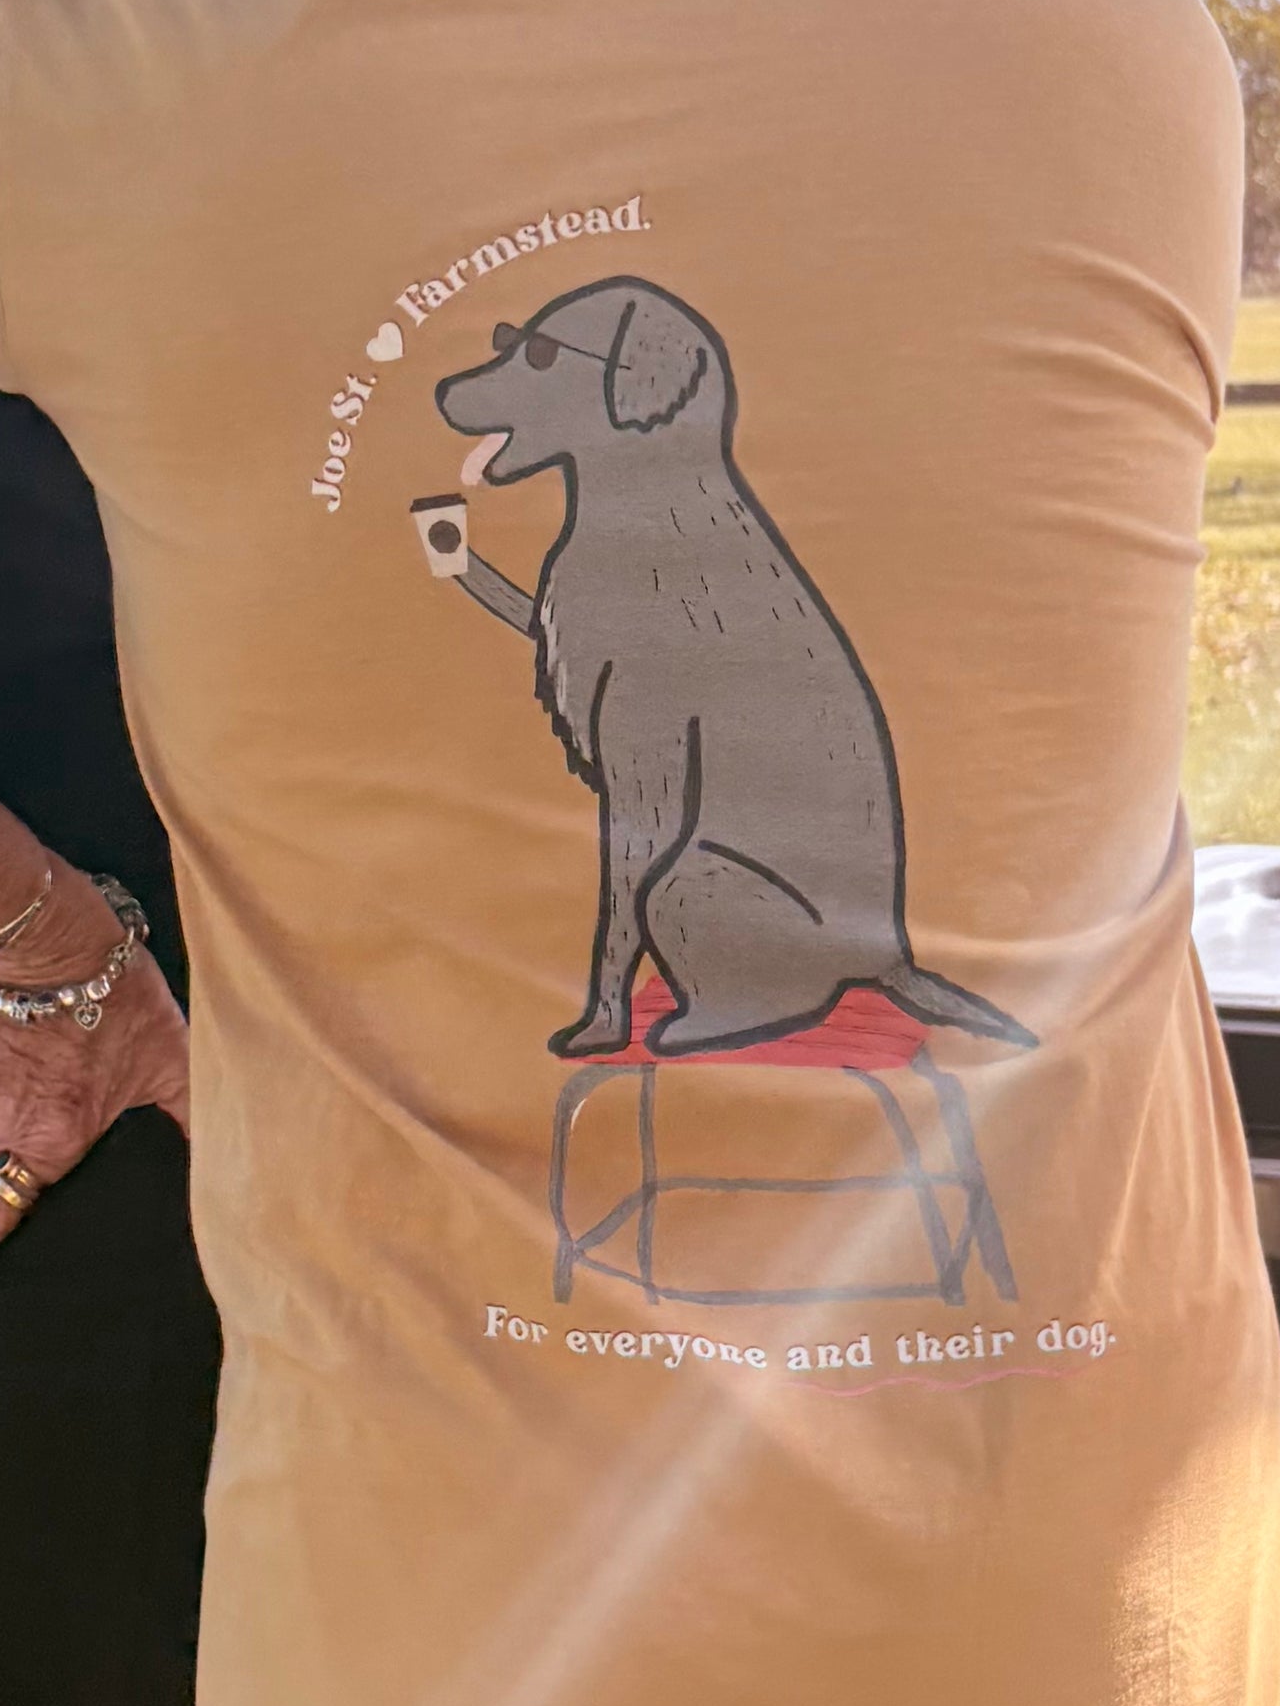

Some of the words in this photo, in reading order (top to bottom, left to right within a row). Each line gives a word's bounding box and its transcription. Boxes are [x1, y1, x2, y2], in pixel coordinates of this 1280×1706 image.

[394, 194, 653, 329] Farmstead.
[330, 372, 378, 426] St.
[311, 428, 353, 514] Joe
[483, 1304, 550, 1345] For
[565, 1327, 769, 1370] everyone
[786, 1334, 873, 1372] and
[895, 1324, 1017, 1364] their
[1035, 1318, 1117, 1359] dog.
